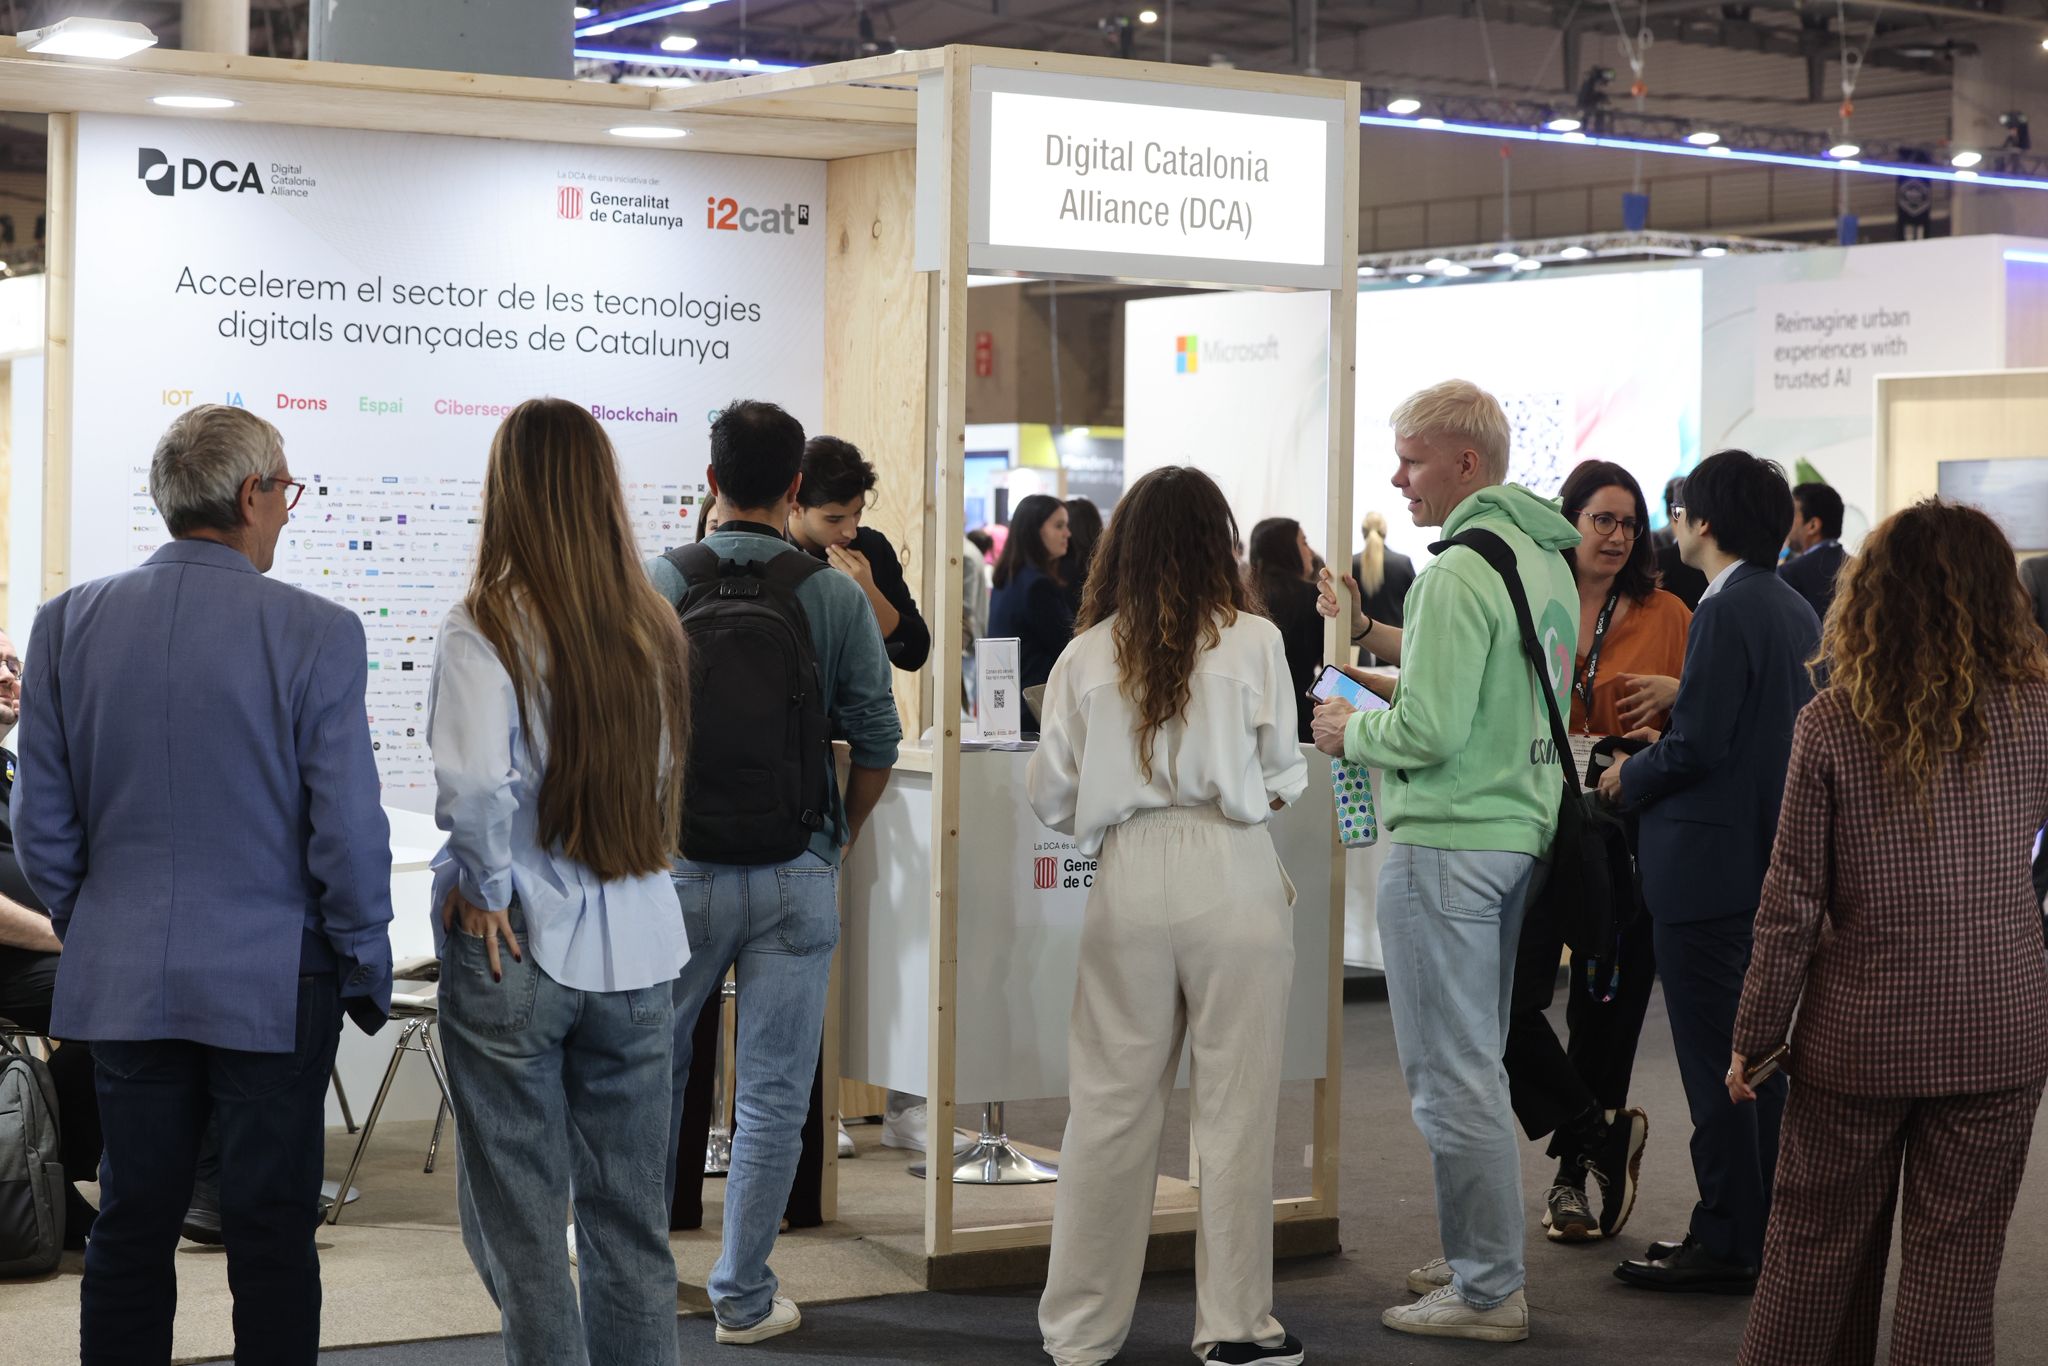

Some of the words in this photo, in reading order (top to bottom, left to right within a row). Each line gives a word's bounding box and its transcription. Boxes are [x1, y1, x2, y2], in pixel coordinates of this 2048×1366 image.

[1046, 134, 1133, 176] Digital
[1144, 141, 1269, 182] Catalonia
[182, 158, 264, 194] DCA
[271, 163, 302, 176] Digital
[568, 171, 586, 181] DCA
[271, 175, 316, 187] Catalonia
[271, 186, 309, 197] Alliance
[590, 191, 670, 210] Generalitat
[590, 209, 608, 222] de
[612, 212, 683, 230] Catalunya
[707, 196, 795, 235] i2cat
[1059, 188, 1169, 227] Alliance
[1180, 196, 1252, 240] (DCA)
[175, 266, 346, 301] Accelerem
[357, 276, 382, 303] el
[392, 282, 488, 307] sector
[498, 283, 535, 309] de
[546, 284, 584, 312] les
[594, 289, 761, 327] tecnologies
[1775, 308, 1858, 337] Reimagine
[1862, 306, 1910, 329] urban
[218, 310, 333, 346] digitals
[344, 321, 518, 354] avançades
[528, 324, 565, 351] de
[576, 326, 730, 365] Catalunya
[1202, 334, 1279, 362] Microsoft
[1774, 338, 1867, 365] experiences
[1871, 335, 1908, 357] with
[1774, 367, 1830, 390] trusted
[1834, 366, 1852, 388] AI
[162, 390, 193, 406] IOT
[226, 391, 244, 408] IA
[276, 394, 327, 410] Drons
[359, 396, 403, 416] Espai
[591, 405, 678, 423] Blockchain
[1034, 843, 1042, 851] La
[1043, 842, 1060, 850] DCA
[1061, 842, 1070, 850] és
[1063, 858, 1097, 872] Gene
[1063, 875, 1079, 889] de
